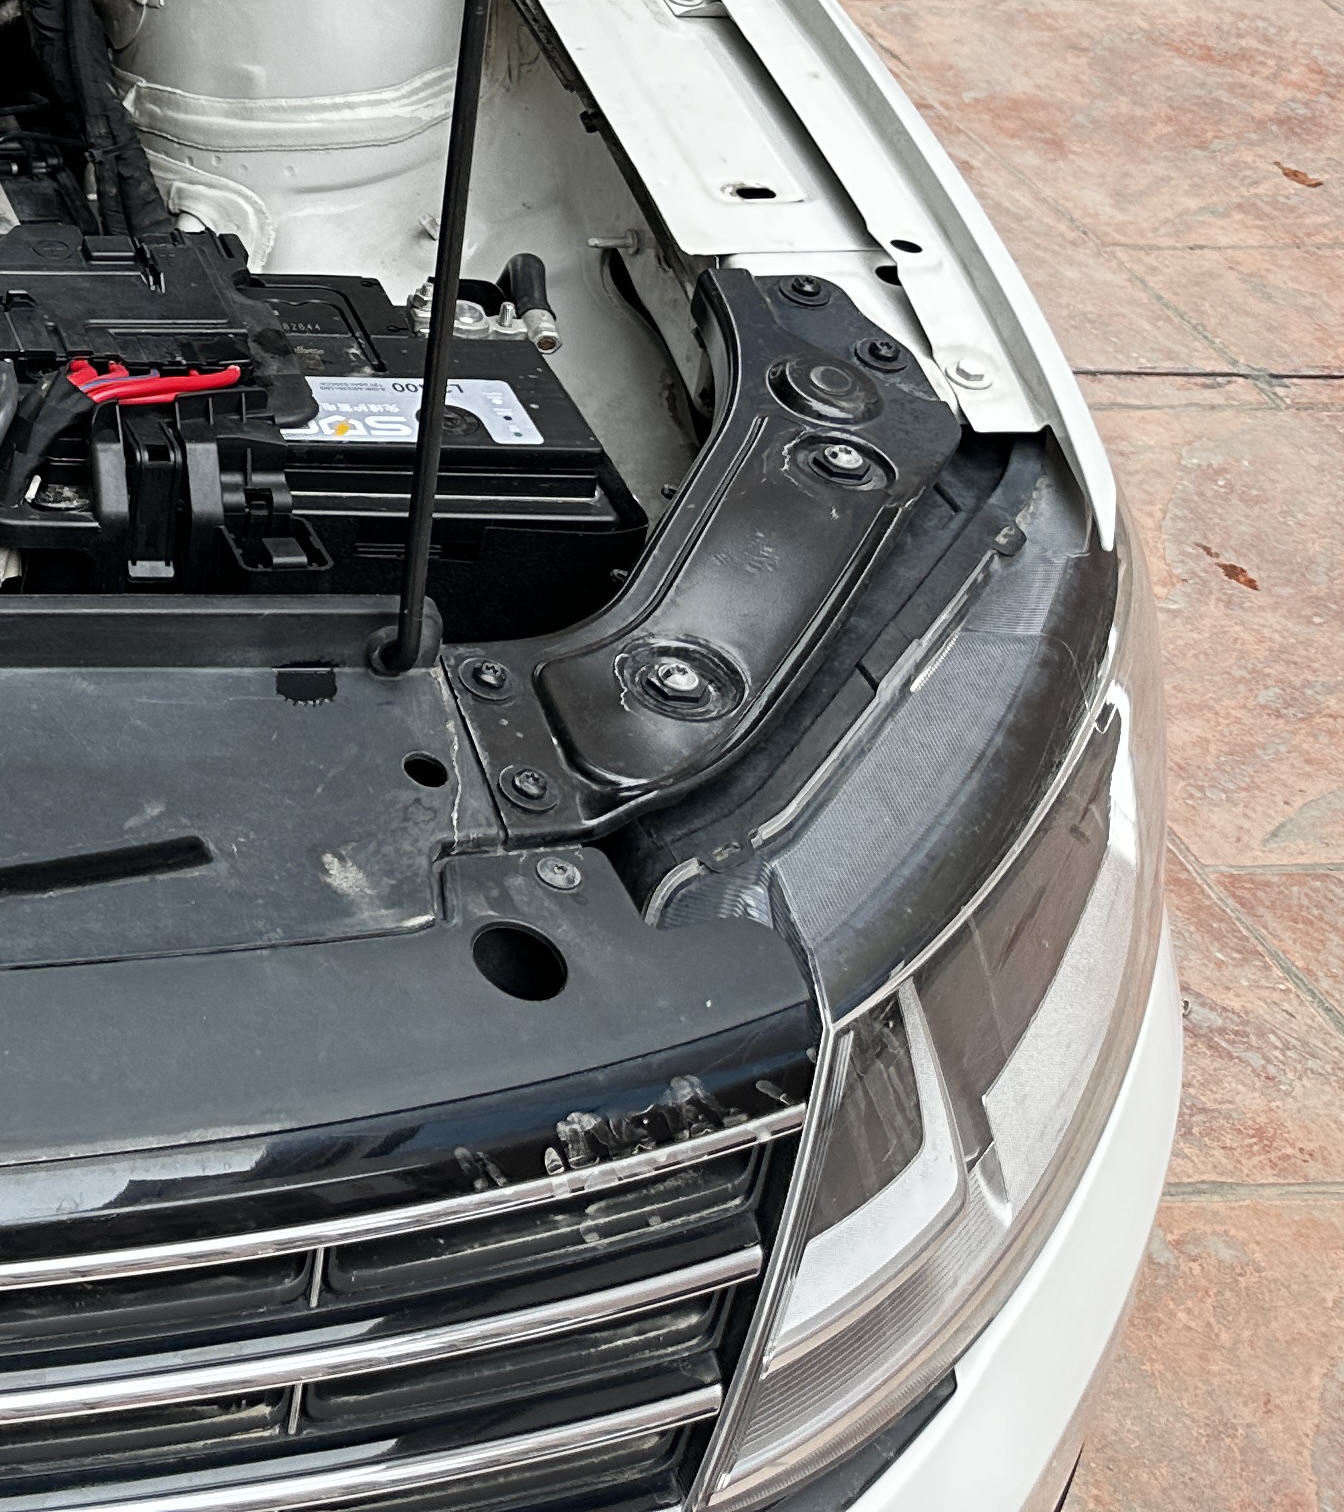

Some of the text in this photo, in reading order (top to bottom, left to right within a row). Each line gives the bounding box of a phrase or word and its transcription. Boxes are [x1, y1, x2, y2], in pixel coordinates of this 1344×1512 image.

[319, 402, 401, 414] 免维护蓄电
